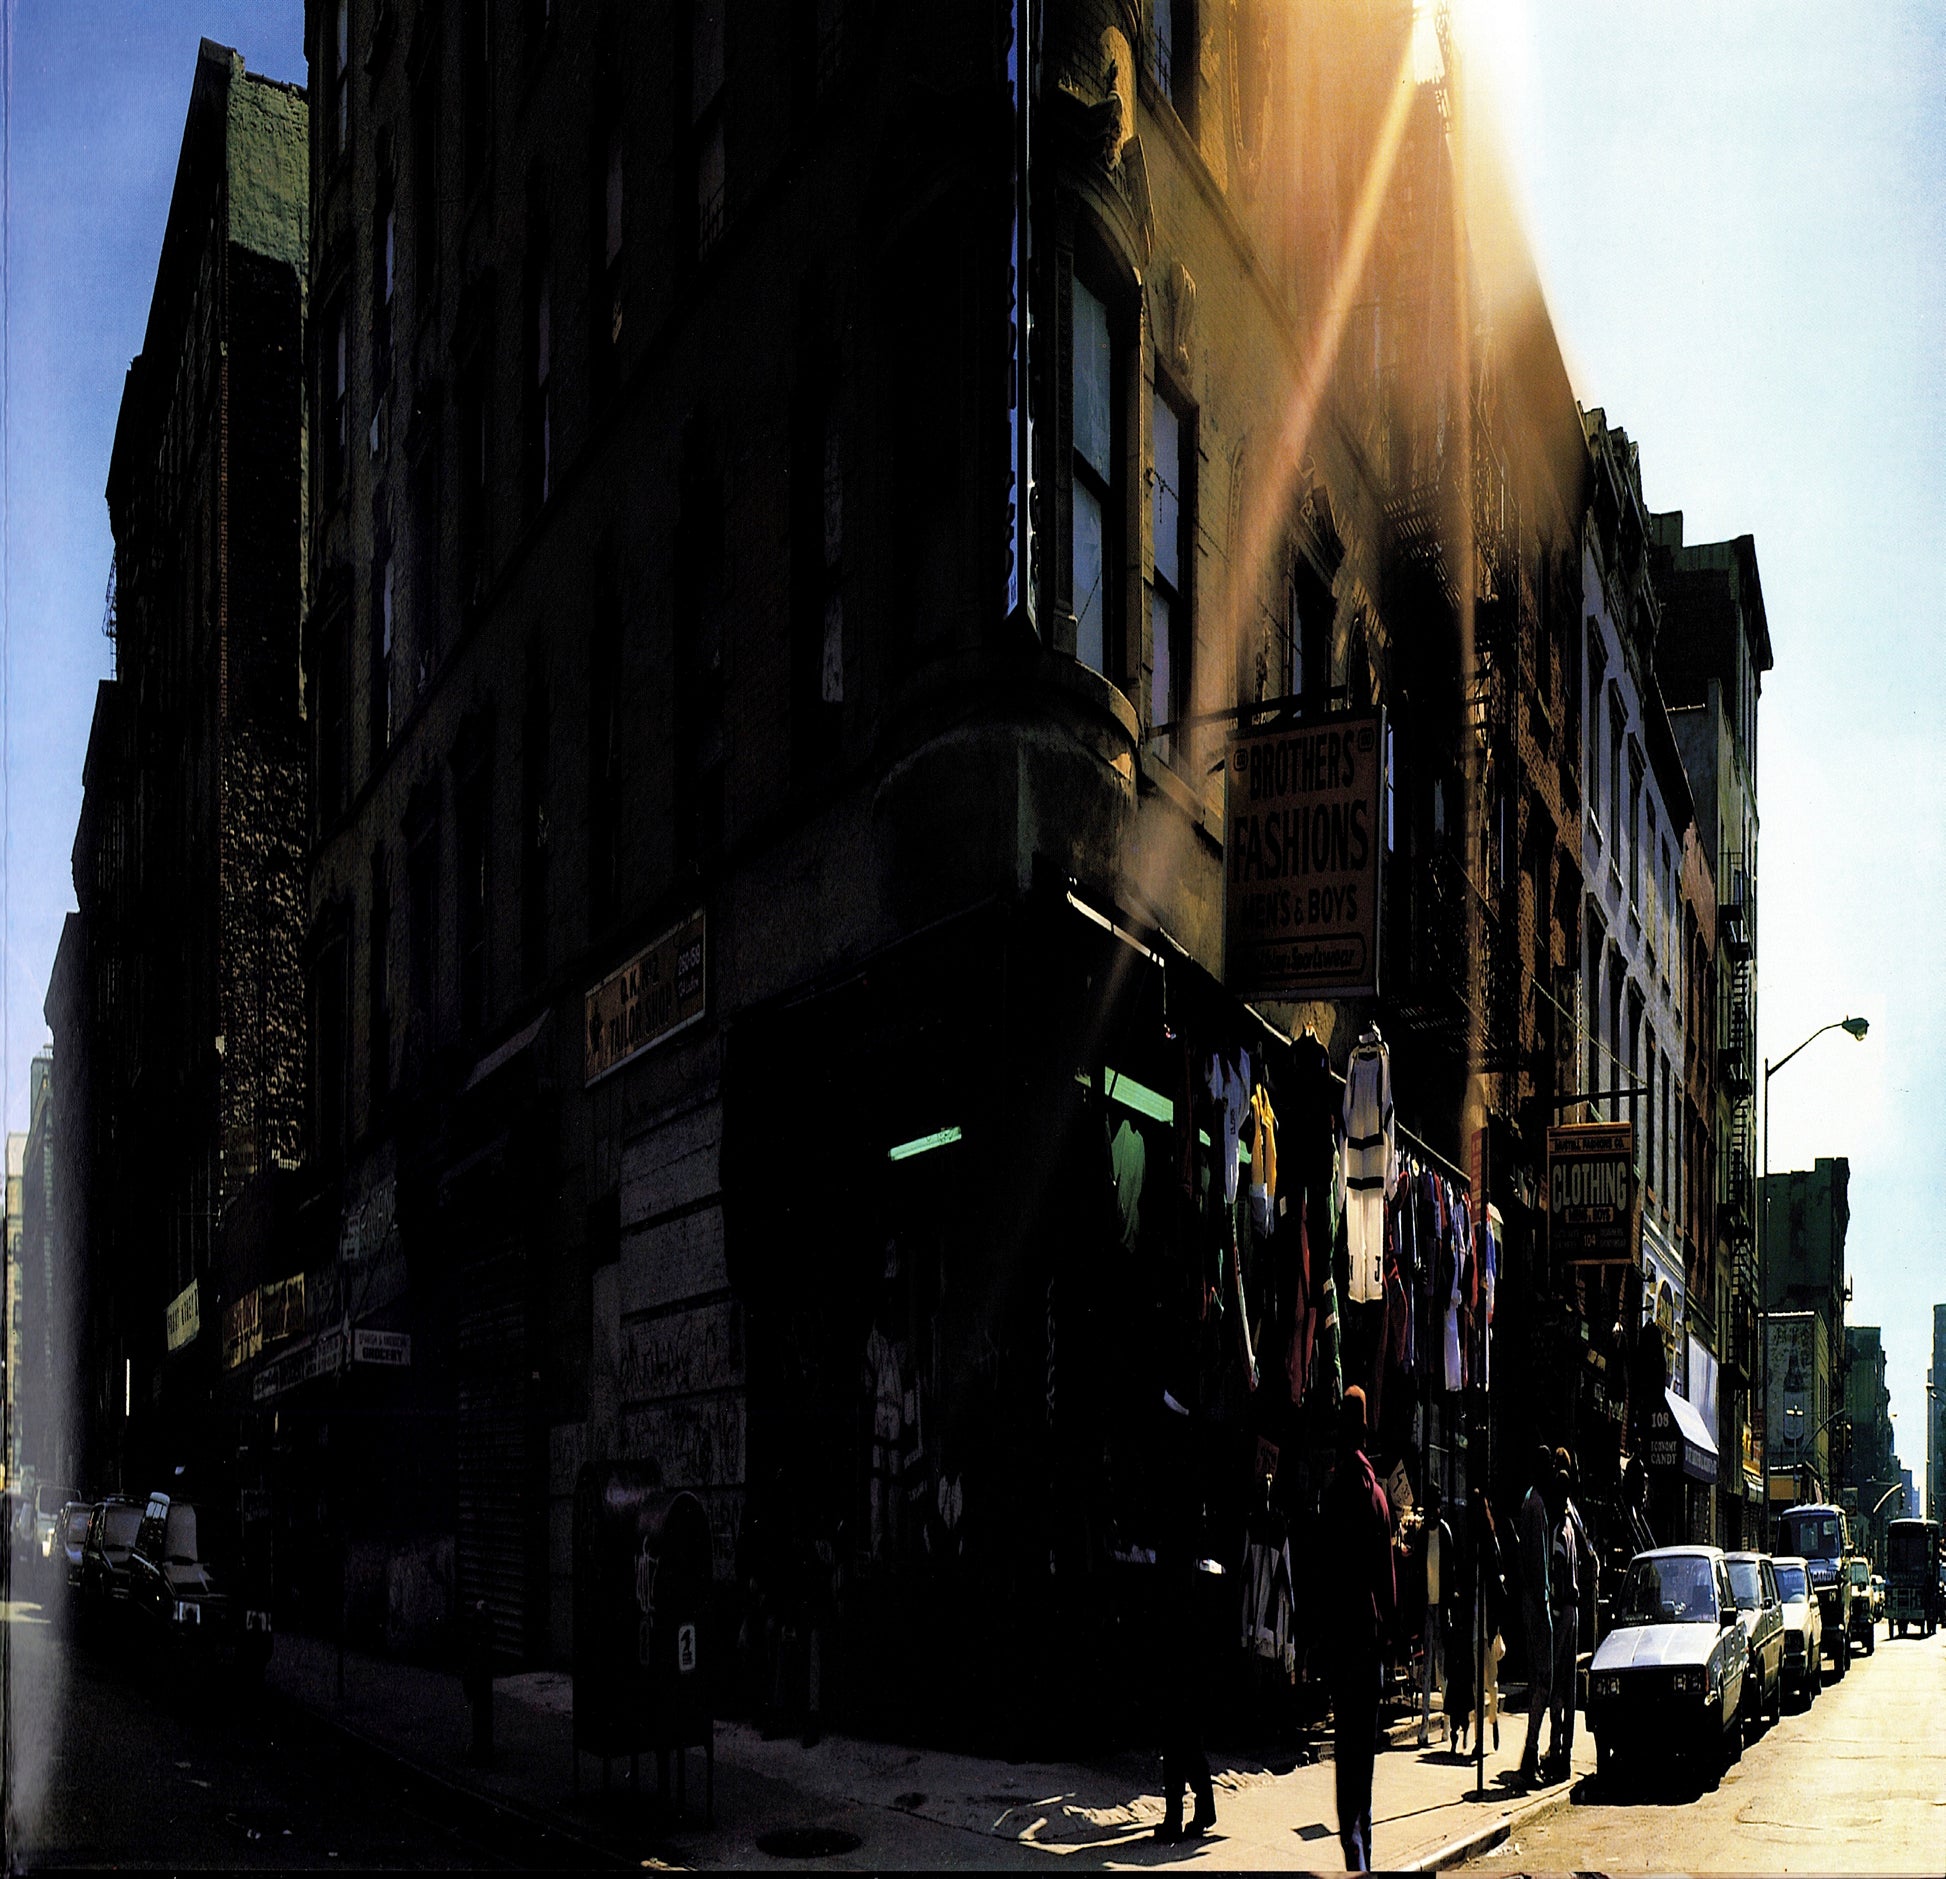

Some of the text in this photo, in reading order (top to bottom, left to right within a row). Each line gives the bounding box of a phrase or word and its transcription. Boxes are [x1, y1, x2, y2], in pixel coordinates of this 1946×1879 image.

[1250, 729, 1355, 800] BROTHERS
[1232, 799, 1368, 883] FASHIONS
[1308, 884, 1357, 925] BOYS
[1552, 1160, 1627, 1214] CLOTHING
[362, 1347, 403, 1362] GROCERY
[1651, 1411, 1670, 1428] 108
[1650, 1453, 1678, 1465] CANDY
